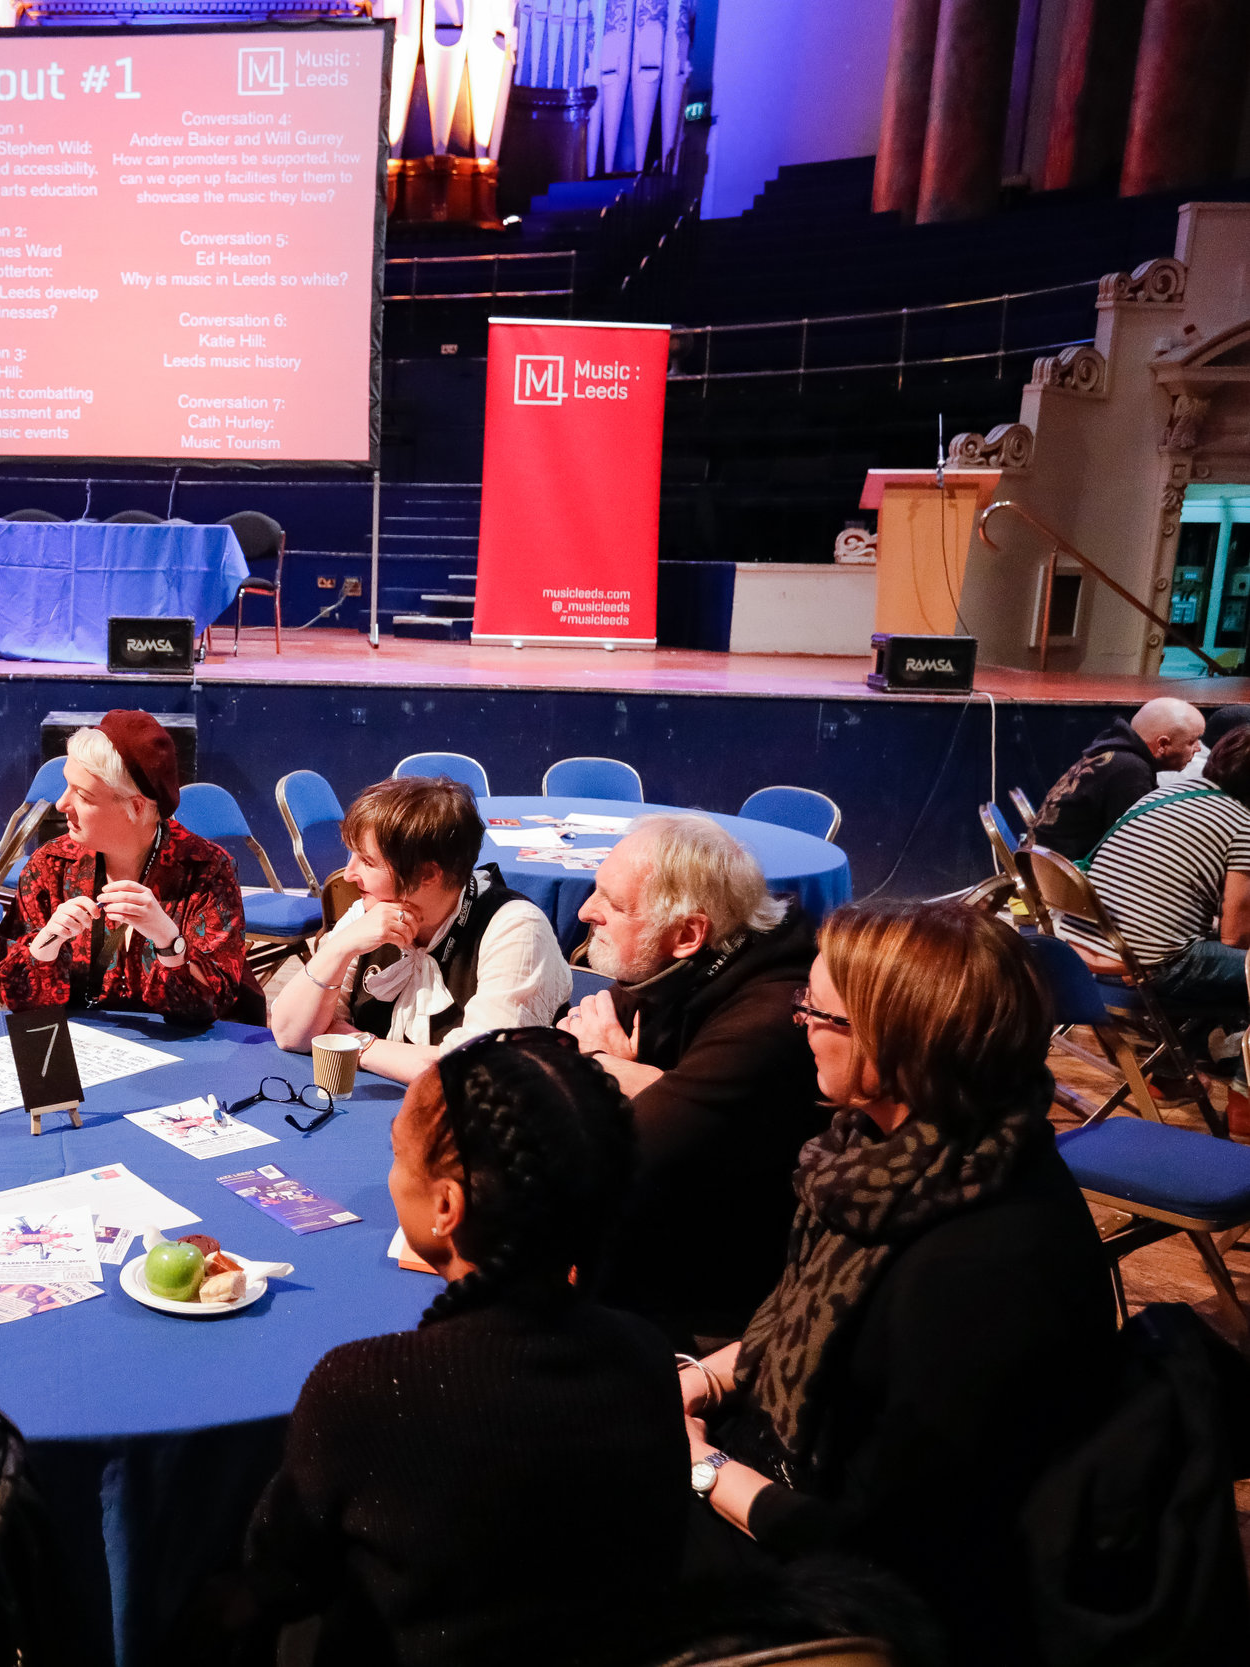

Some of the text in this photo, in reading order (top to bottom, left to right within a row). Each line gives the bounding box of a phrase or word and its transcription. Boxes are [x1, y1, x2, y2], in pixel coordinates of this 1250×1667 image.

[295, 48, 351, 68] Music
[79, 56, 142, 100] #1
[295, 68, 349, 87] Leeds
[181, 110, 292, 126] Conversation 4:
[18, 123, 24, 134] 1
[129, 130, 344, 148] Andrew Baker and Will Gurrey
[58, 141, 93, 155] Wild:
[112, 153, 142, 166] How
[145, 155, 170, 166] can
[172, 154, 238, 169] promoters
[241, 152, 258, 165] be
[333, 150, 361, 164] how
[119, 171, 353, 187] can we open up facilities for them to
[0, 183, 27, 197] arts
[30, 182, 98, 197] education
[136, 189, 335, 205] showcase the music they love?
[15, 226, 28, 238] 2:
[180, 230, 289, 248] Conversation 5:
[25, 243, 62, 258] Ward
[196, 251, 271, 266] Ed Heaton
[120, 271, 349, 290] Why is music in Leeds so white?
[0, 285, 41, 299] Leeds
[45, 285, 99, 302] develop
[178, 312, 287, 328] Conversation 6:
[199, 333, 267, 348] Katie Hill:
[14, 348, 27, 362] 3:
[163, 353, 301, 372] Leeds music history
[575, 359, 630, 380] Music
[18, 386, 94, 404] combatting
[574, 380, 628, 400] Leeds
[177, 394, 286, 412] Conversation 7:
[55, 406, 81, 419] and
[187, 414, 274, 433] Cath Hurley:
[24, 426, 69, 439] events
[180, 434, 281, 449] Music Tourism
[542, 587, 631, 600] musicleeds.com
[551, 600, 630, 614] @_musicleeds
[559, 613, 630, 626] #musicleeds
[126, 638, 174, 652] RAMSA
[905, 658, 954, 672] RAMSA
[26, 1022, 60, 1078] 7
